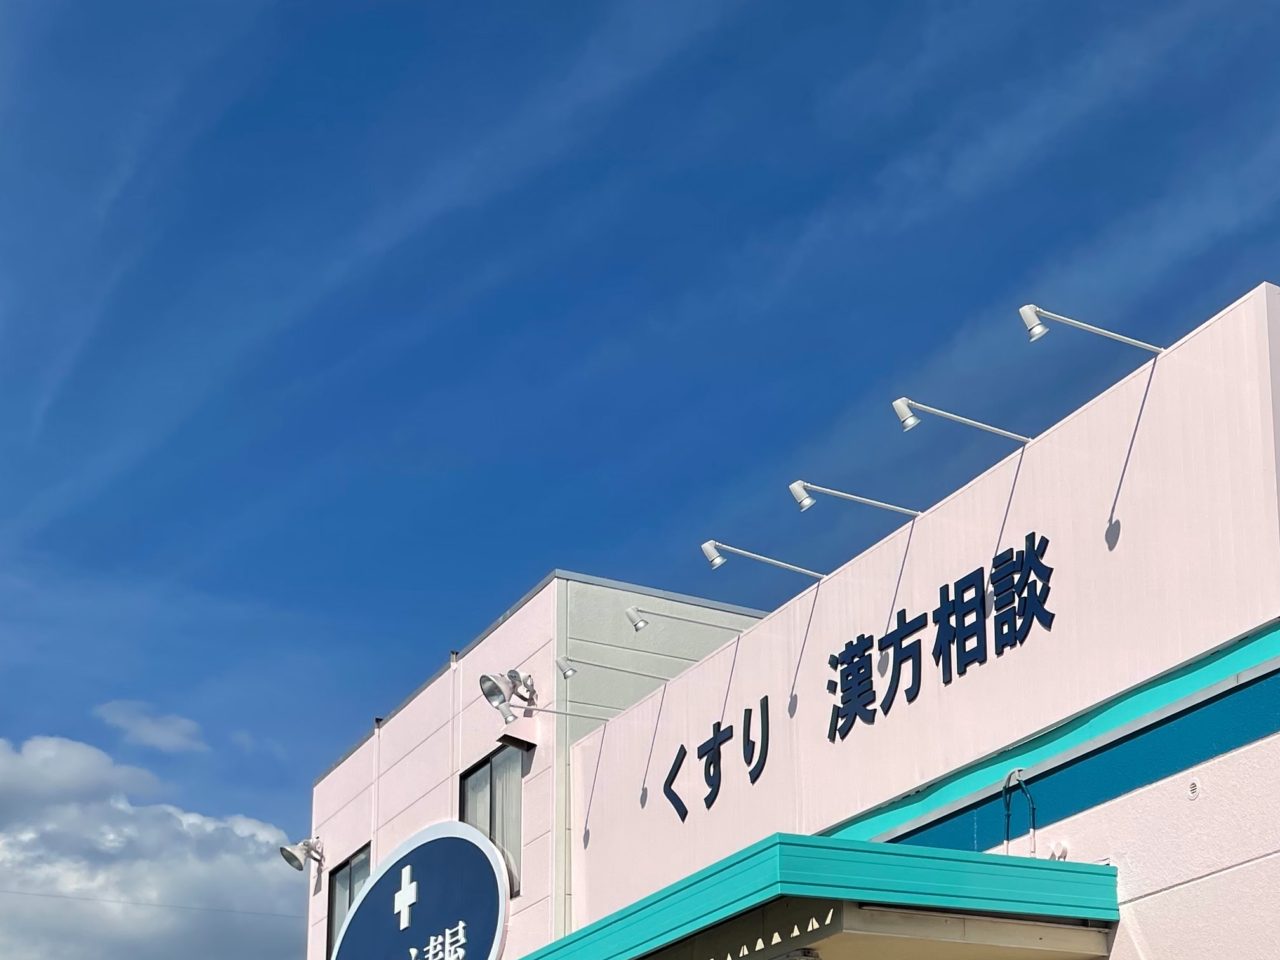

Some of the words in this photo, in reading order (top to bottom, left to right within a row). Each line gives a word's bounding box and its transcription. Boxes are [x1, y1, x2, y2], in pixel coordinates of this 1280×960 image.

[663, 695, 769, 824] くすり
[826, 531, 1055, 743] 漢方相談
